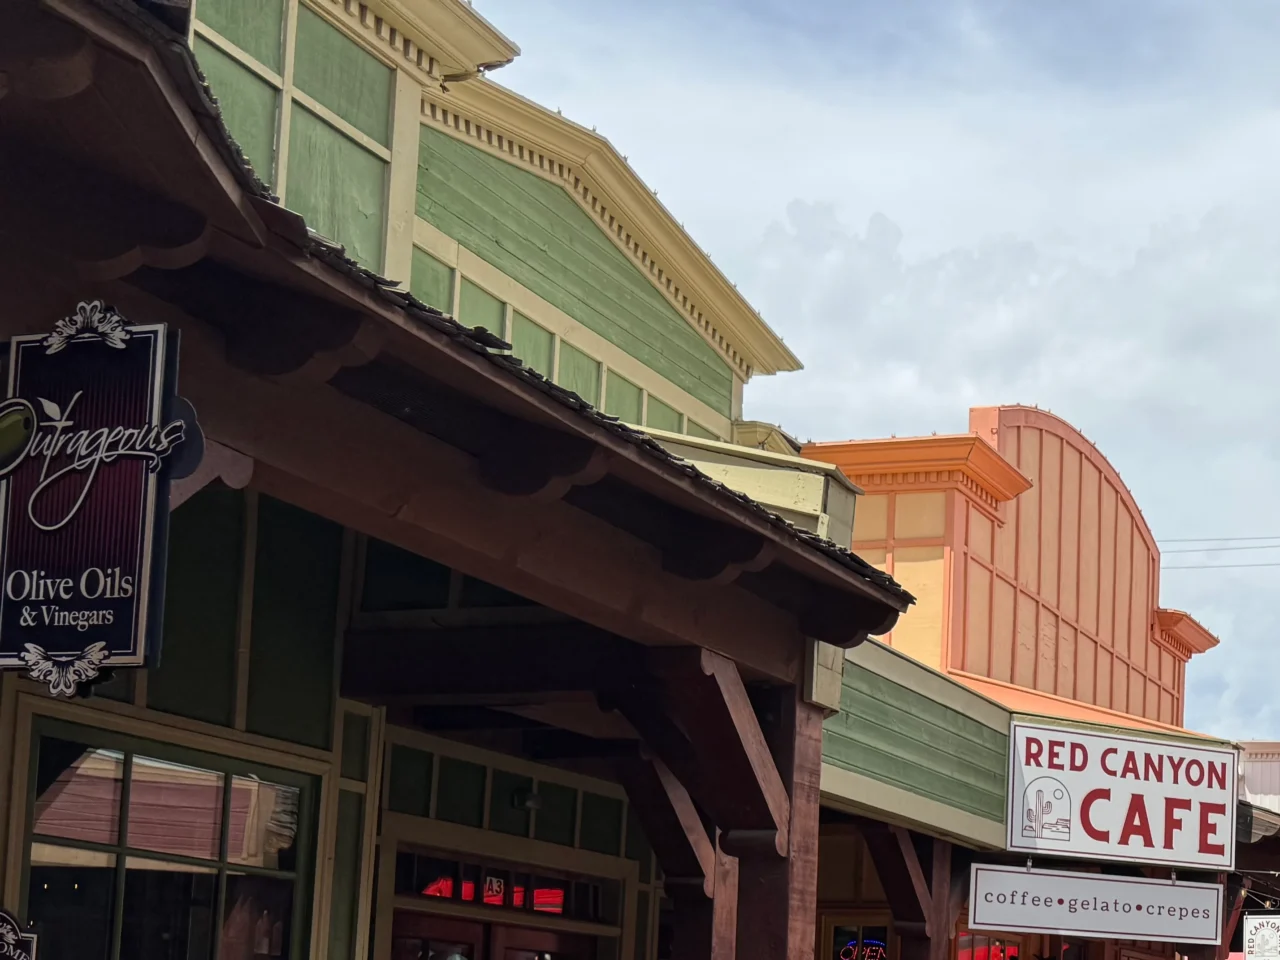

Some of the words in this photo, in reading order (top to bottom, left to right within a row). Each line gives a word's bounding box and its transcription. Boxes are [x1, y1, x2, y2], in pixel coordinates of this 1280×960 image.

[6, 569, 74, 602] Olive
[80, 567, 133, 599] Oils
[19, 608, 38, 627] &
[40, 605, 114, 631] Vinegars
[1024, 736, 1089, 772] RED
[1100, 748, 1228, 791] CANYON
[1079, 787, 1227, 857] CAFE
[487, 878, 503, 894] A3
[984, 889, 1054, 907] coffee
[1068, 896, 1132, 914] gelato
[1146, 903, 1211, 920] crepes
[840, 946, 887, 960] OPEN
